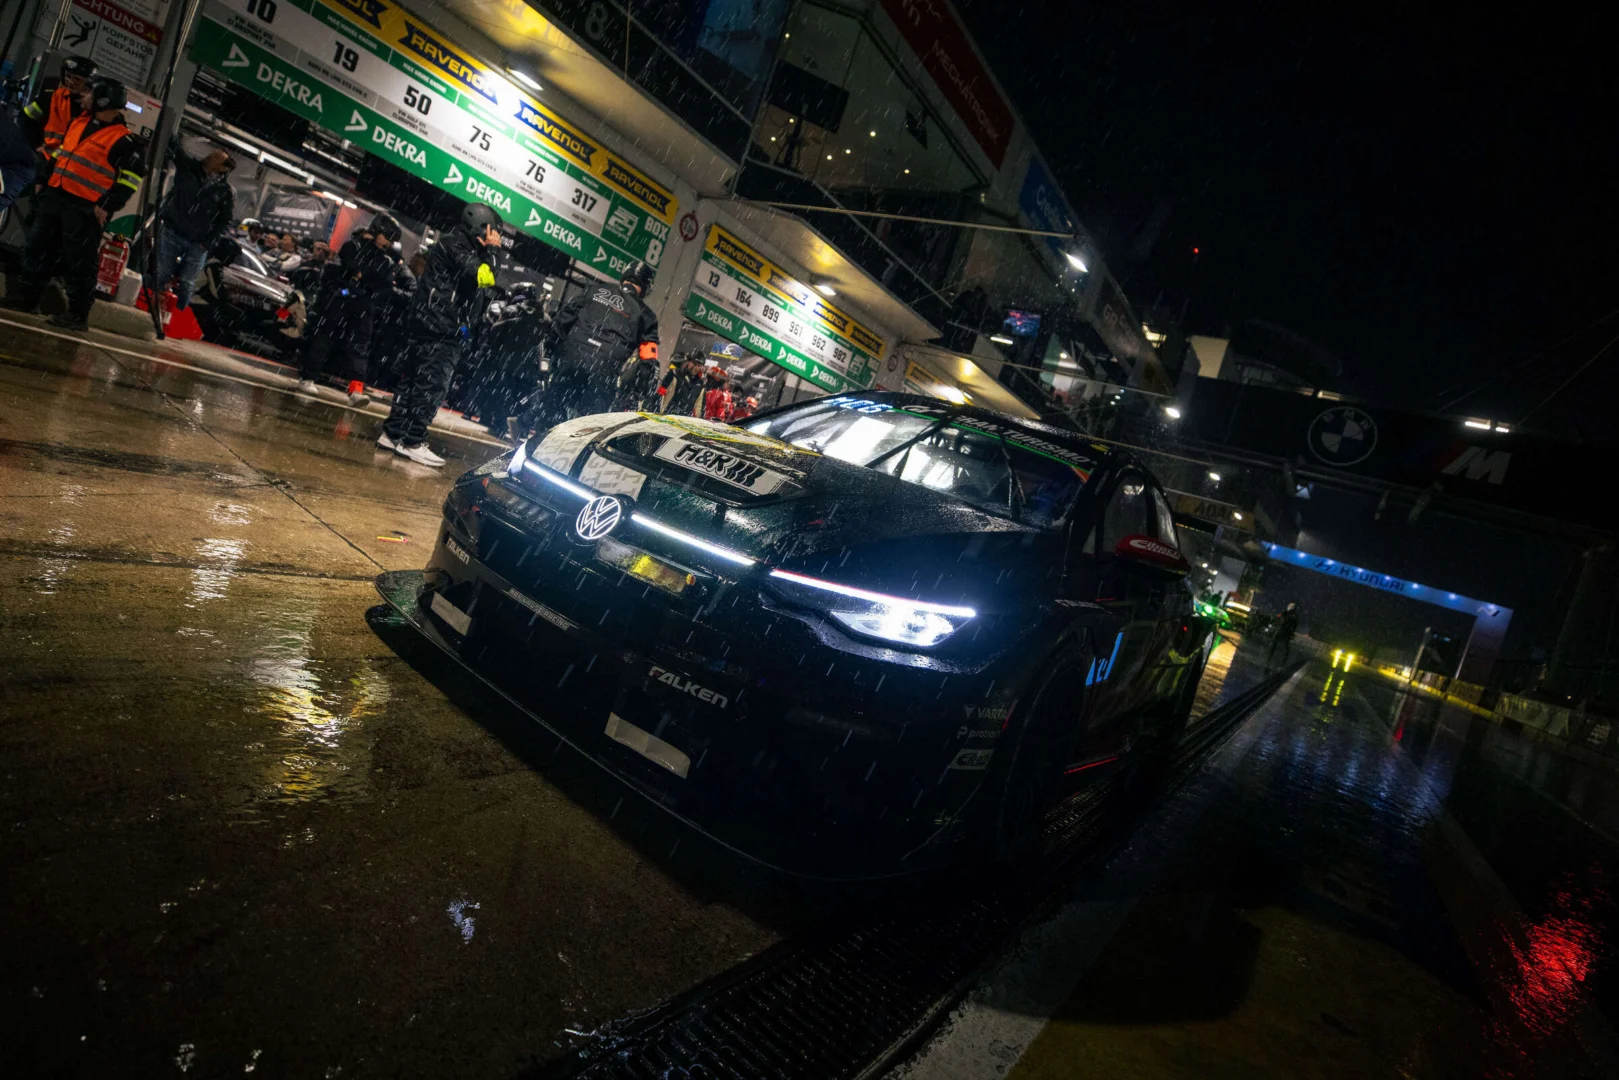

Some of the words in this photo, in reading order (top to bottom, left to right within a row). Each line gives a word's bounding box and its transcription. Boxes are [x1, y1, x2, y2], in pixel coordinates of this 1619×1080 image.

[585, 2, 608, 40] 8
[333, 40, 359, 72] 19
[256, 61, 323, 112] DEKRA
[403, 84, 433, 116] 50
[142, 127, 151, 138] 8
[469, 124, 493, 152] 75
[520, 106, 588, 159] RAVENOL
[372, 125, 427, 168] DEKRA
[525, 159, 546, 184] 76
[465, 176, 512, 213] DEKRA
[571, 187, 597, 213] 317
[609, 165, 666, 209] RAVENOL
[543, 219, 582, 251] DEKRA
[644, 215, 668, 242] BOX
[645, 238, 664, 266] 8
[720, 241, 760, 272] RAVENOL
[708, 270, 720, 287] 13
[736, 288, 752, 307] 164
[707, 310, 733, 332] DEKRA
[762, 304, 780, 323] 899
[750, 332, 772, 353] DEKRA
[789, 321, 803, 338] 961
[812, 335, 826, 351] 962
[786, 351, 806, 371] DEKRA
[833, 347, 847, 363] 982
[818, 370, 837, 387] DEKRA
[1002, 429, 1090, 463] TURISMO
[1441, 446, 1513, 485] M
[445, 538, 471, 565] FALKEN
[1339, 566, 1404, 591] HYUNDAI
[544, 608, 570, 631] RACING
[648, 666, 729, 709] FALKEN
[977, 706, 1008, 720] VARTA
